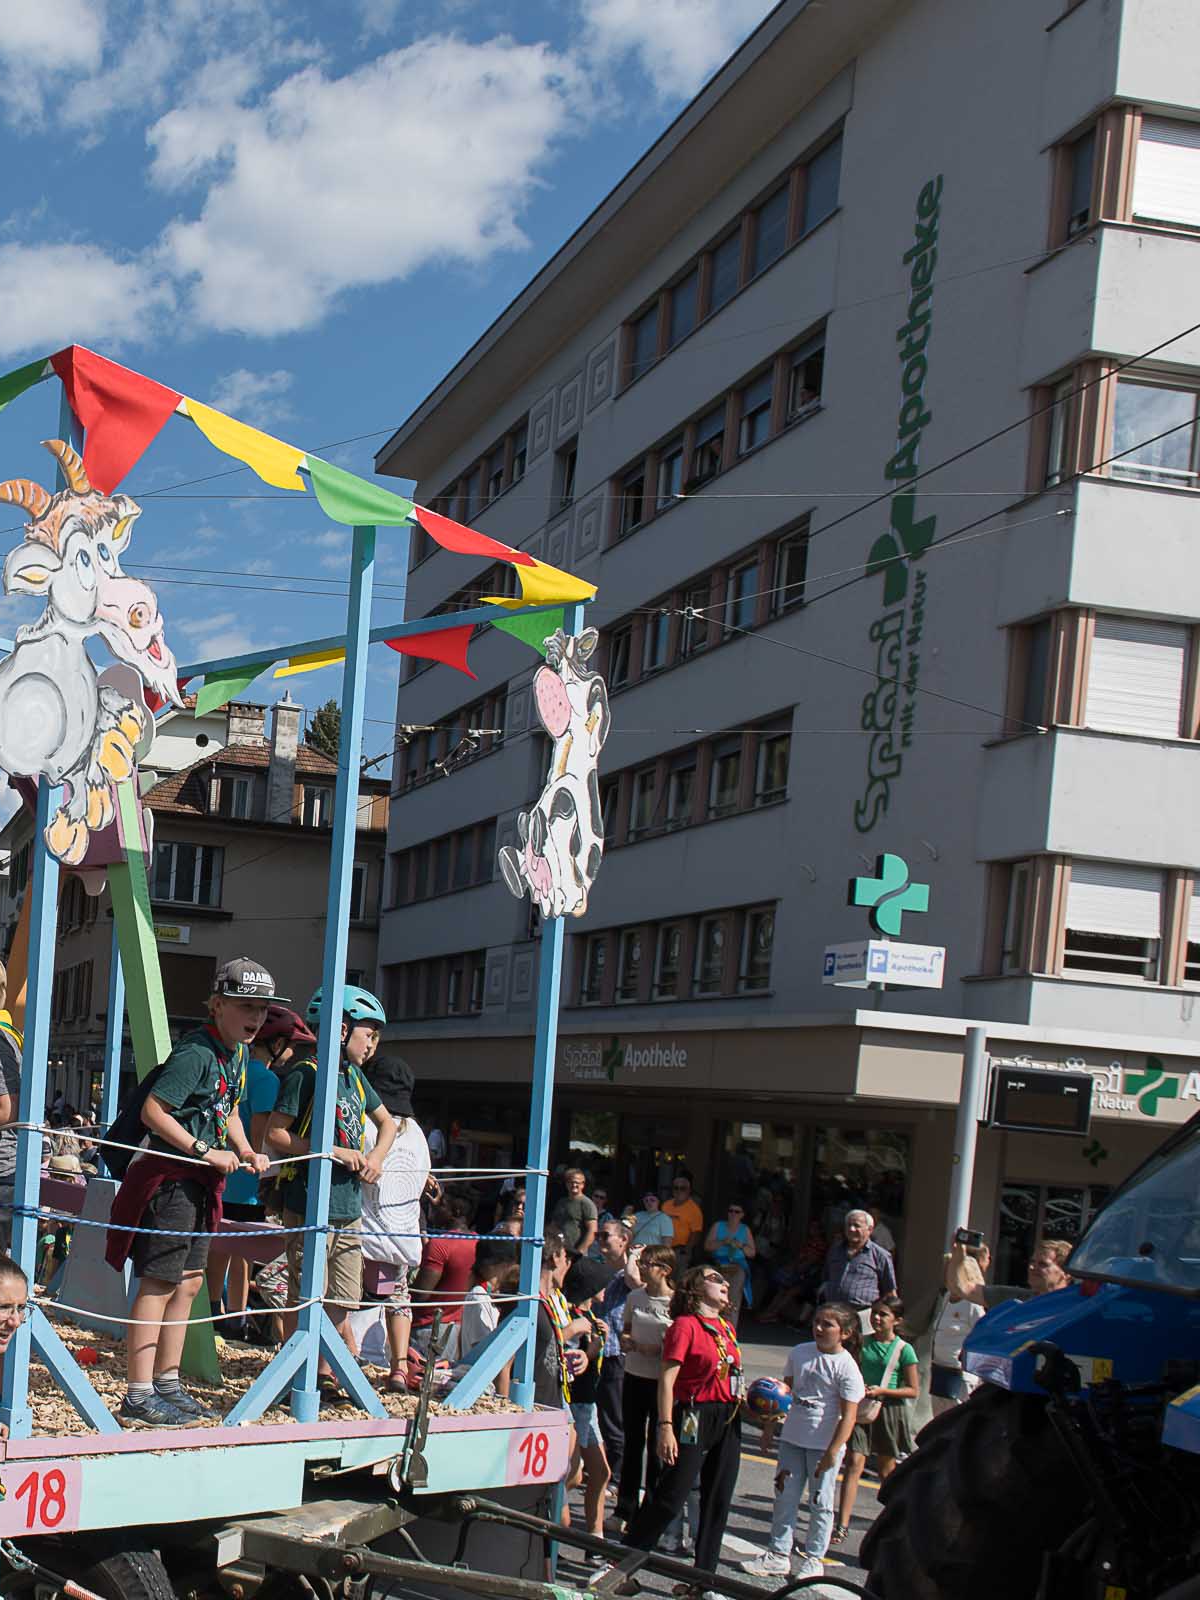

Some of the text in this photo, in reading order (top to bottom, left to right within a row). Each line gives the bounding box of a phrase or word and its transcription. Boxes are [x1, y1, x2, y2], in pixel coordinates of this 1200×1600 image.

[854, 173, 944, 833] Späni Apotheke
[900, 568, 927, 749] mit der Natur
[871, 952, 885, 968] P
[624, 1042, 688, 1072] Apotheke
[1098, 1095, 1136, 1112] Natur
[518, 1432, 549, 1478] 18
[14, 1468, 67, 1529] 18
